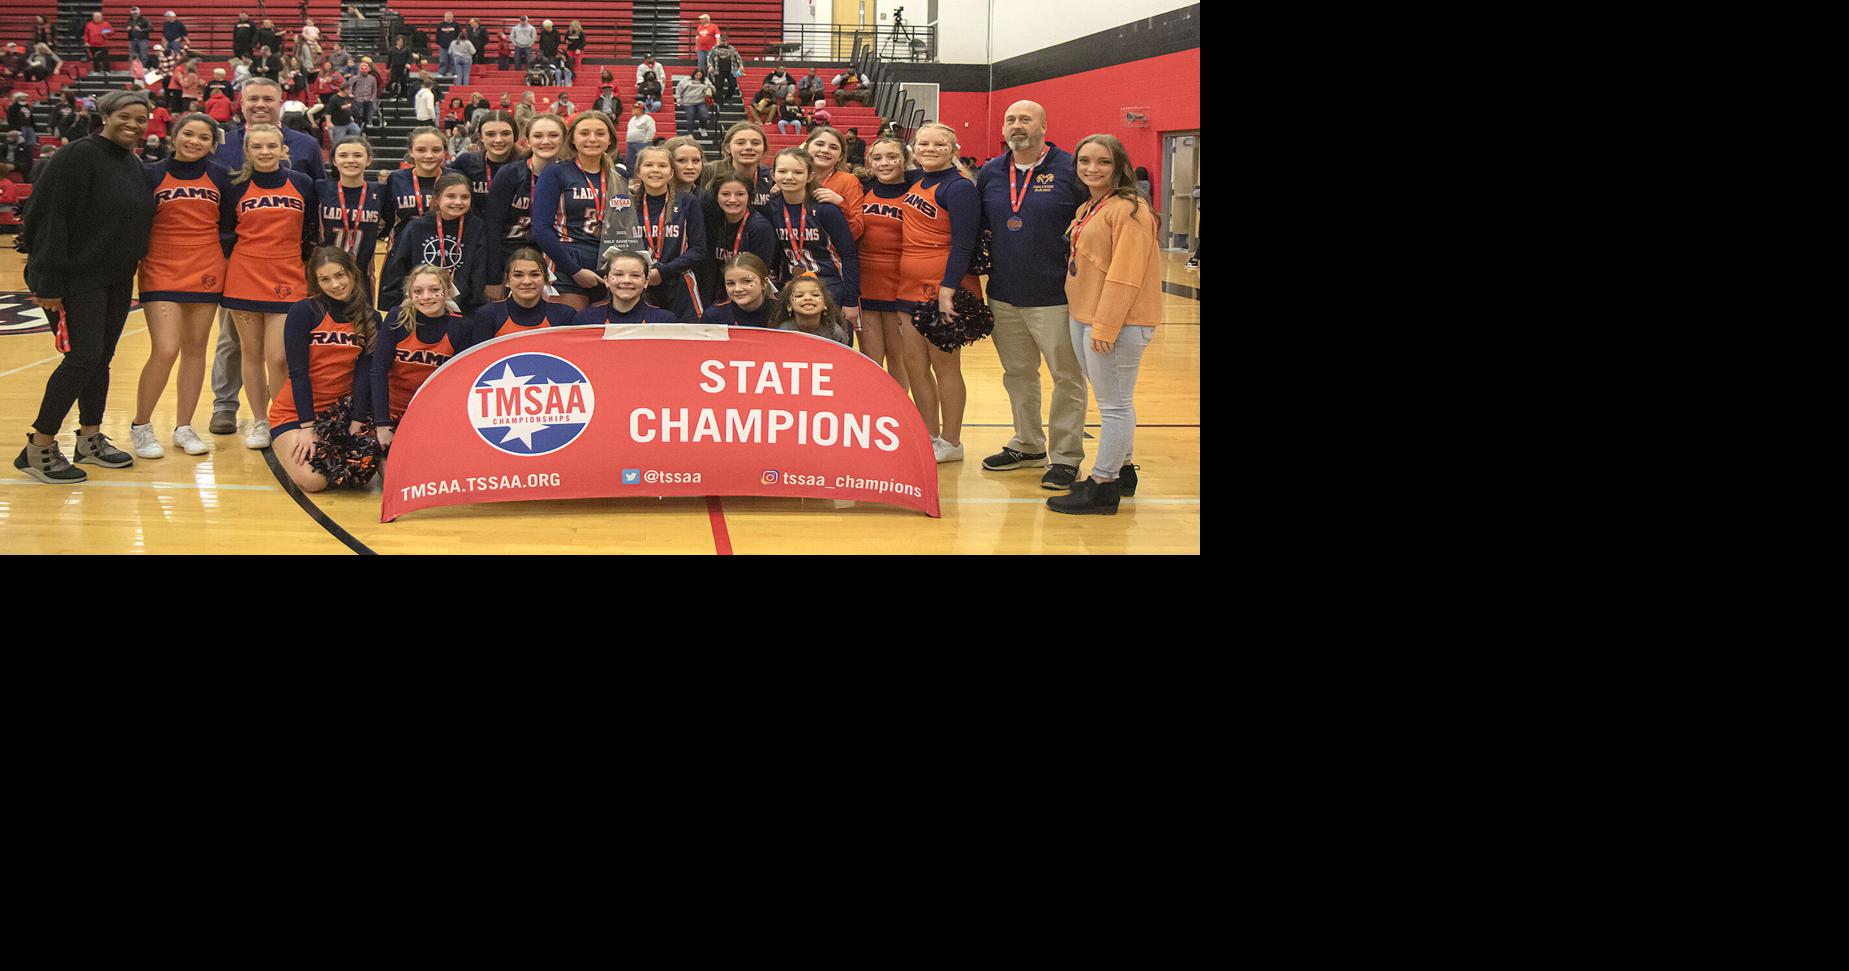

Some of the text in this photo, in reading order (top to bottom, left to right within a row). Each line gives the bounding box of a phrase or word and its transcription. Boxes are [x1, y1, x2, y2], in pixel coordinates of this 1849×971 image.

[155, 187, 221, 206] RAMS
[240, 195, 304, 215] RAMS
[902, 192, 937, 219] AMS
[652, 225, 679, 237] RMS
[792, 227, 820, 241] RMS
[310, 331, 363, 349] RAM
[395, 348, 452, 367] RAM
[699, 359, 834, 397] STATE
[475, 384, 586, 418] TMSAA
[492, 415, 571, 425] CHAMPIONSHIPS
[629, 407, 901, 452] CHAMPIONS
[643, 469, 702, 484] @tssaa
[783, 471, 922, 498] tssaa_champions
[400, 472, 561, 502] TMSAA.TSSAA.ORG
